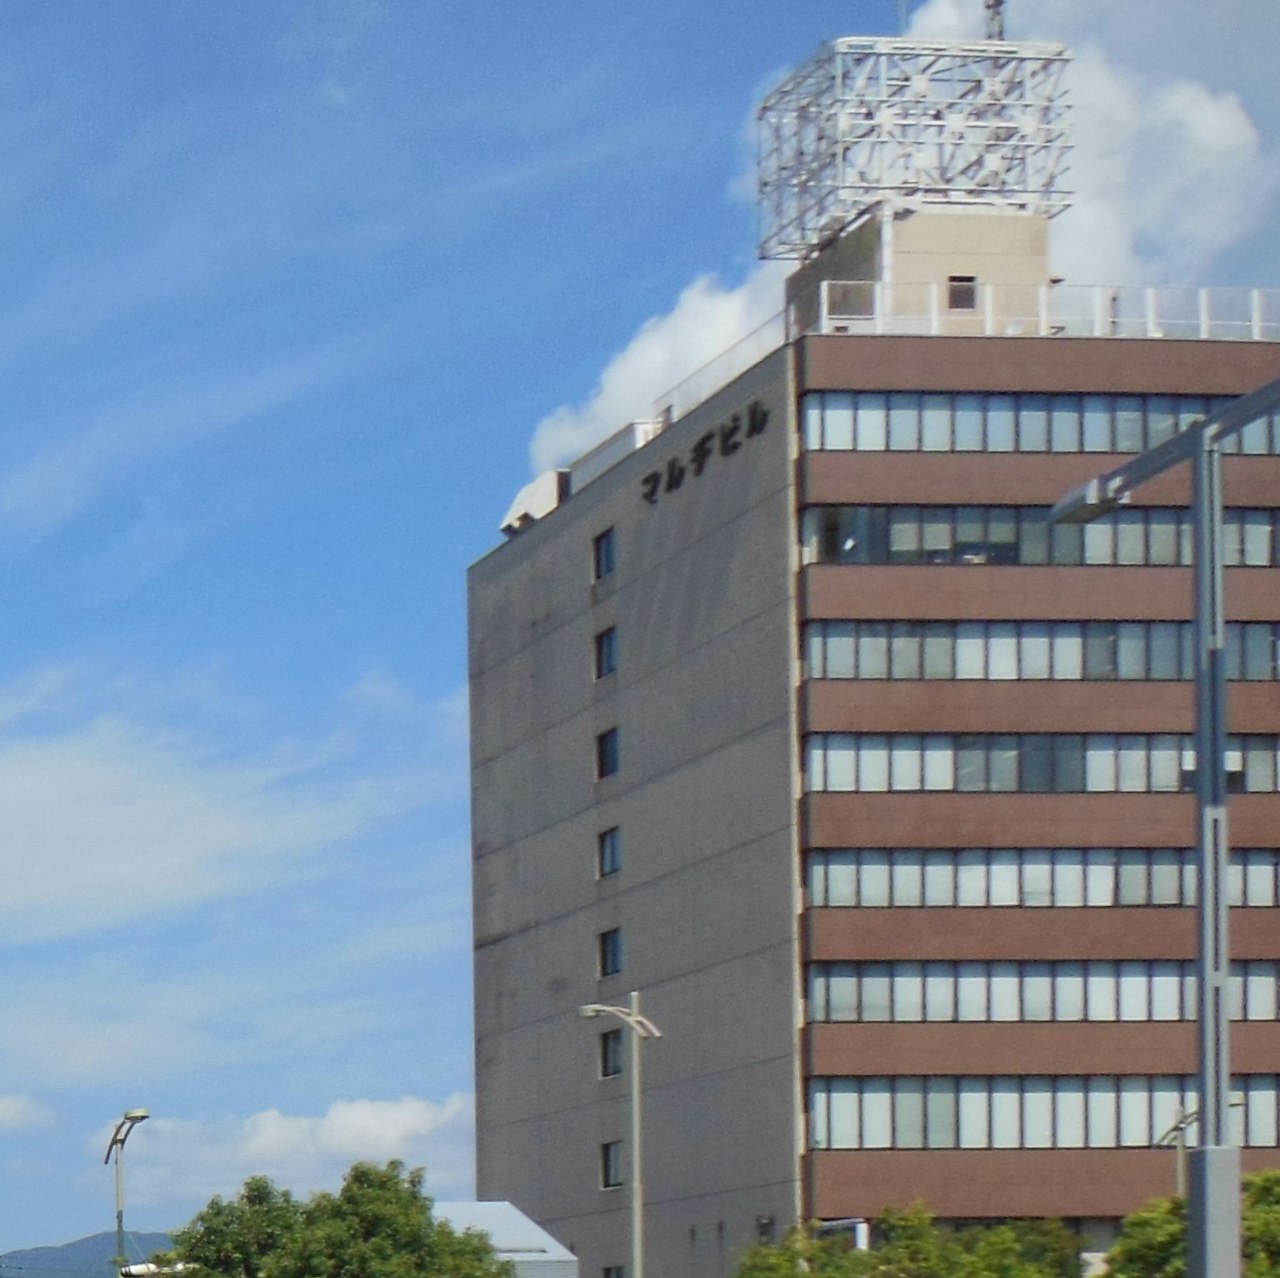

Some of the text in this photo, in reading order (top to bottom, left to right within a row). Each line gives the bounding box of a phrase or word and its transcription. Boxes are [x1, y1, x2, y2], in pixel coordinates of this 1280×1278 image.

[641, 400, 770, 505] マルチビル
